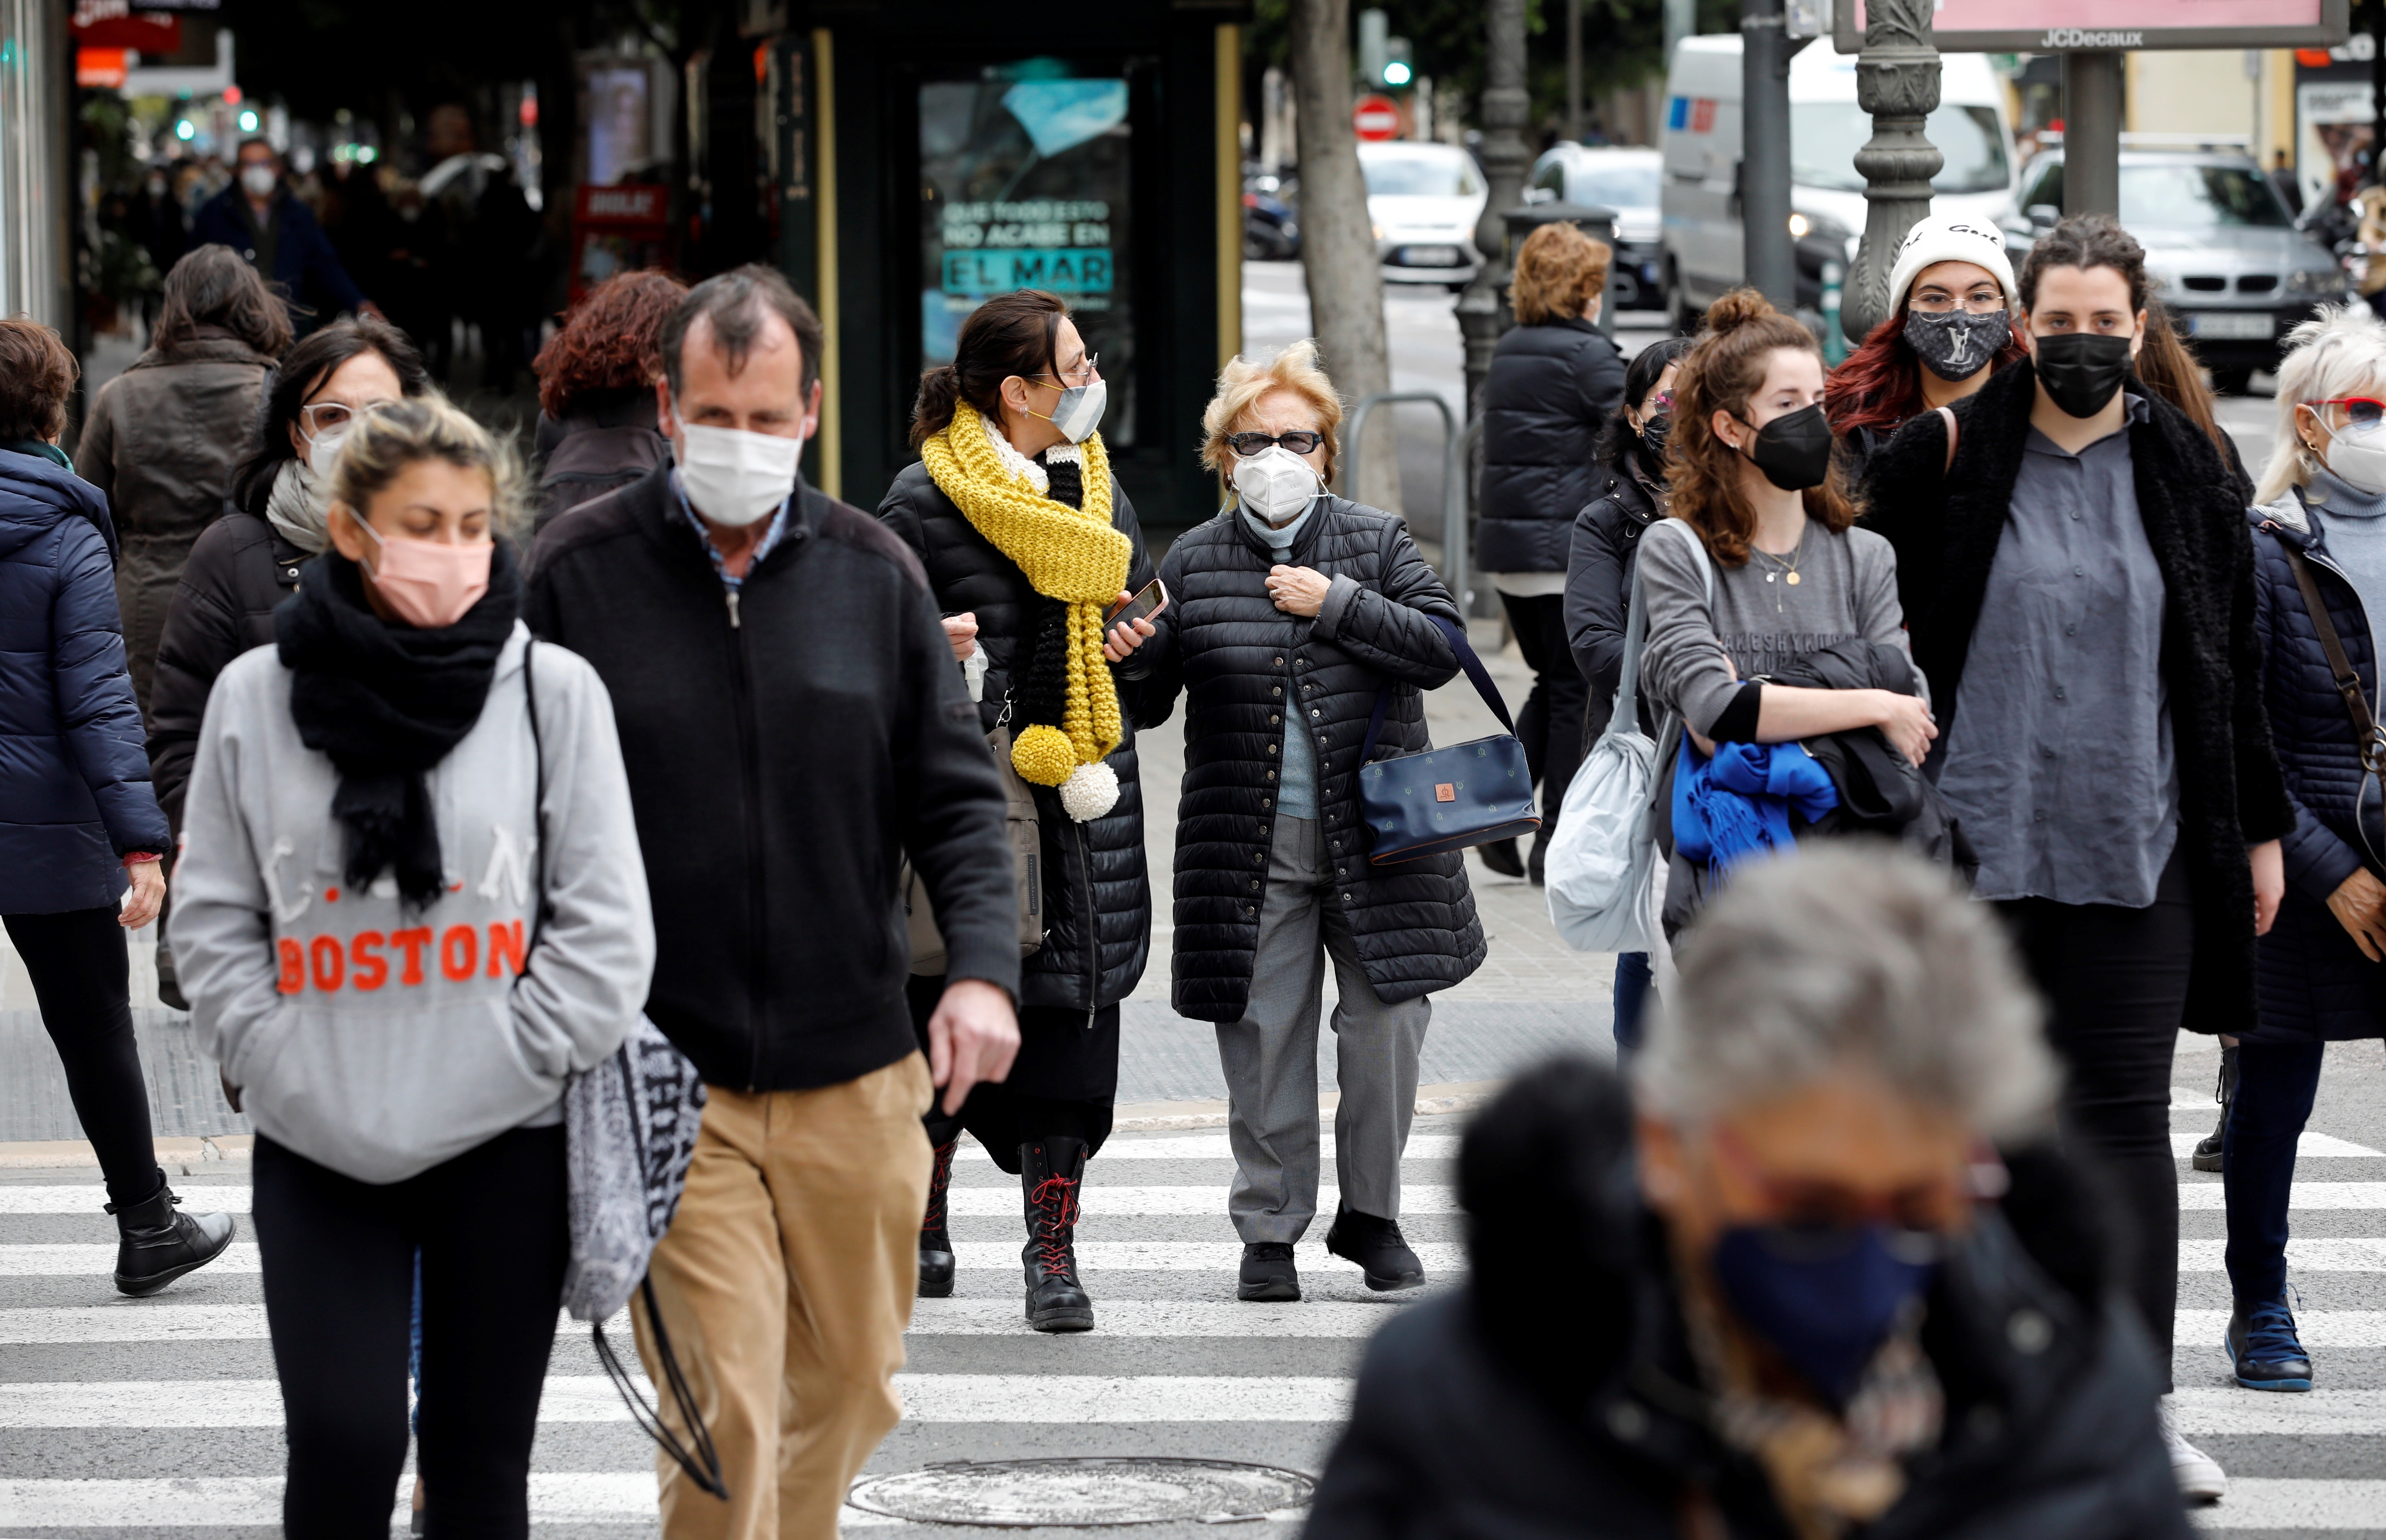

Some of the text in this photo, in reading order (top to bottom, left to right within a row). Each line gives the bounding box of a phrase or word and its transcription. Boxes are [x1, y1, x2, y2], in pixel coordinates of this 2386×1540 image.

[2041, 28, 2143, 47] JCDecaux
[943, 200, 1110, 223] QUE TODO ESTO
[943, 222, 1110, 247] NO ACABE EN
[951, 256, 1105, 285] EL MAR
[276, 918, 525, 994] BOSTON
